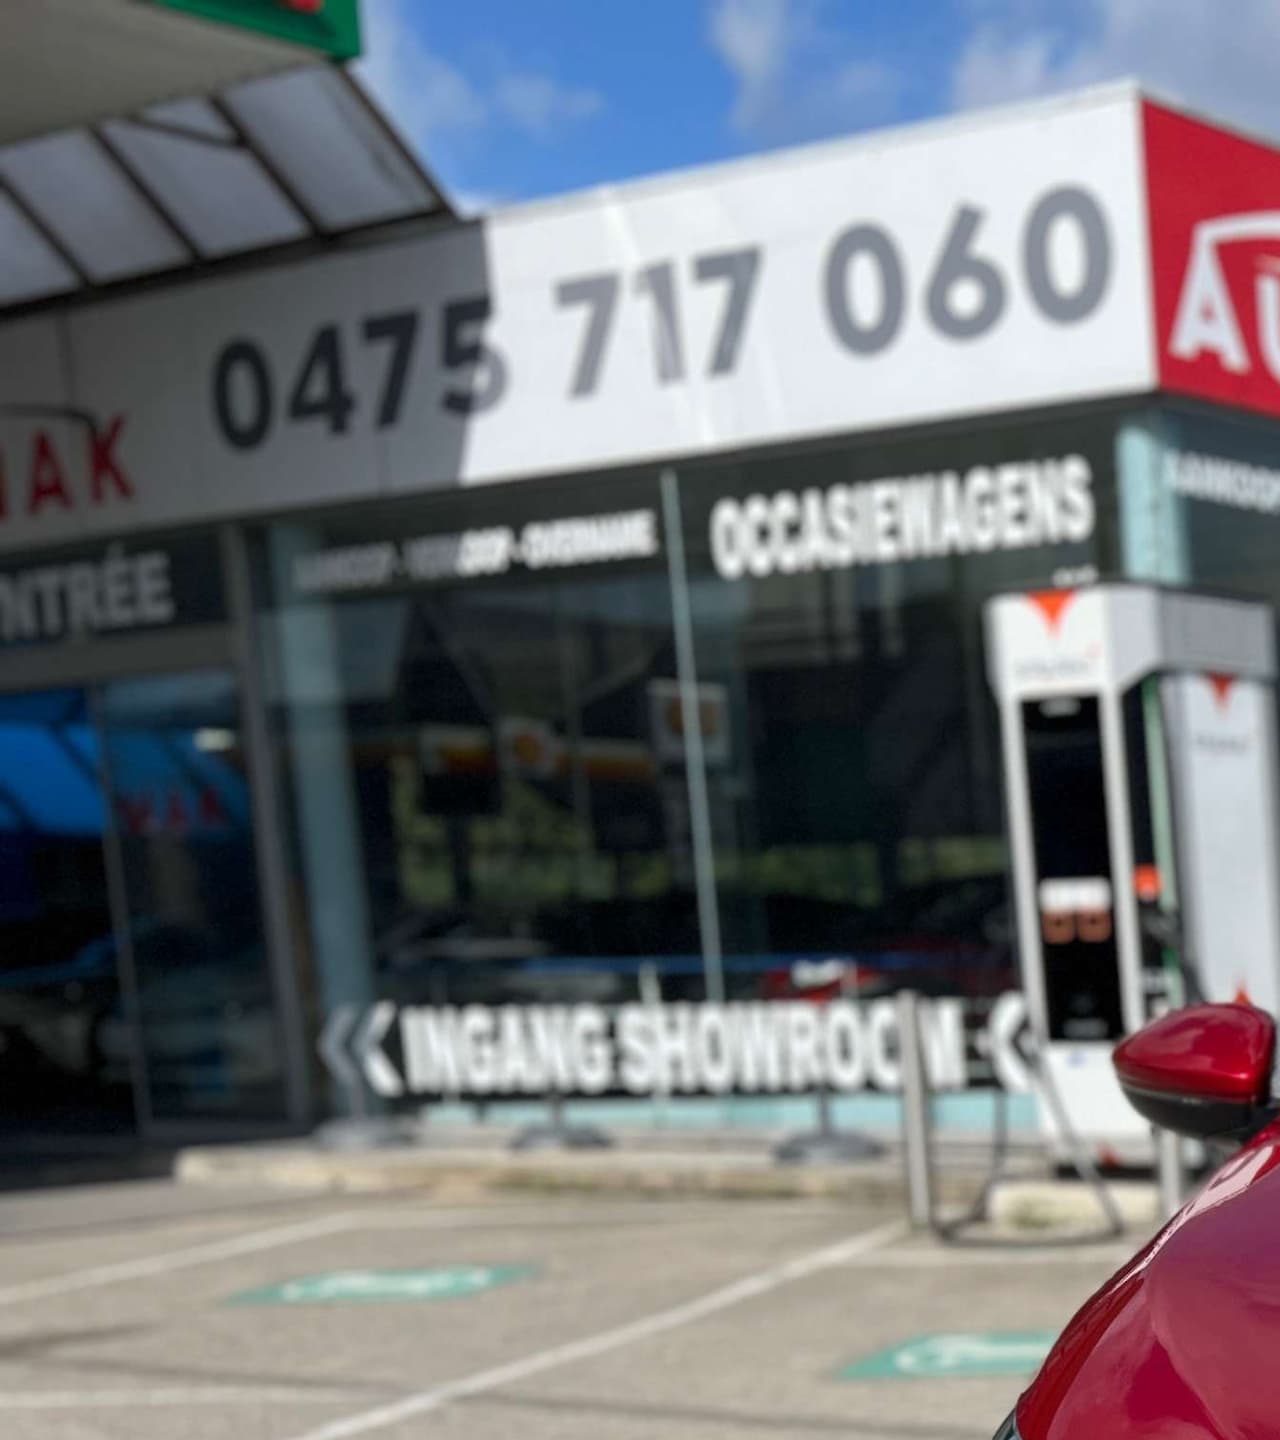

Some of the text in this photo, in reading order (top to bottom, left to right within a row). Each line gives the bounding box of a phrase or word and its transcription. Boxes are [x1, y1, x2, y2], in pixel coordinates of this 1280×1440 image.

[210, 182, 1114, 450] 0475 717 060
[0, 412, 134, 523] AK
[708, 455, 1096, 579] OCCASIEWAGENS
[402, 1000, 611, 1096] INGANG
